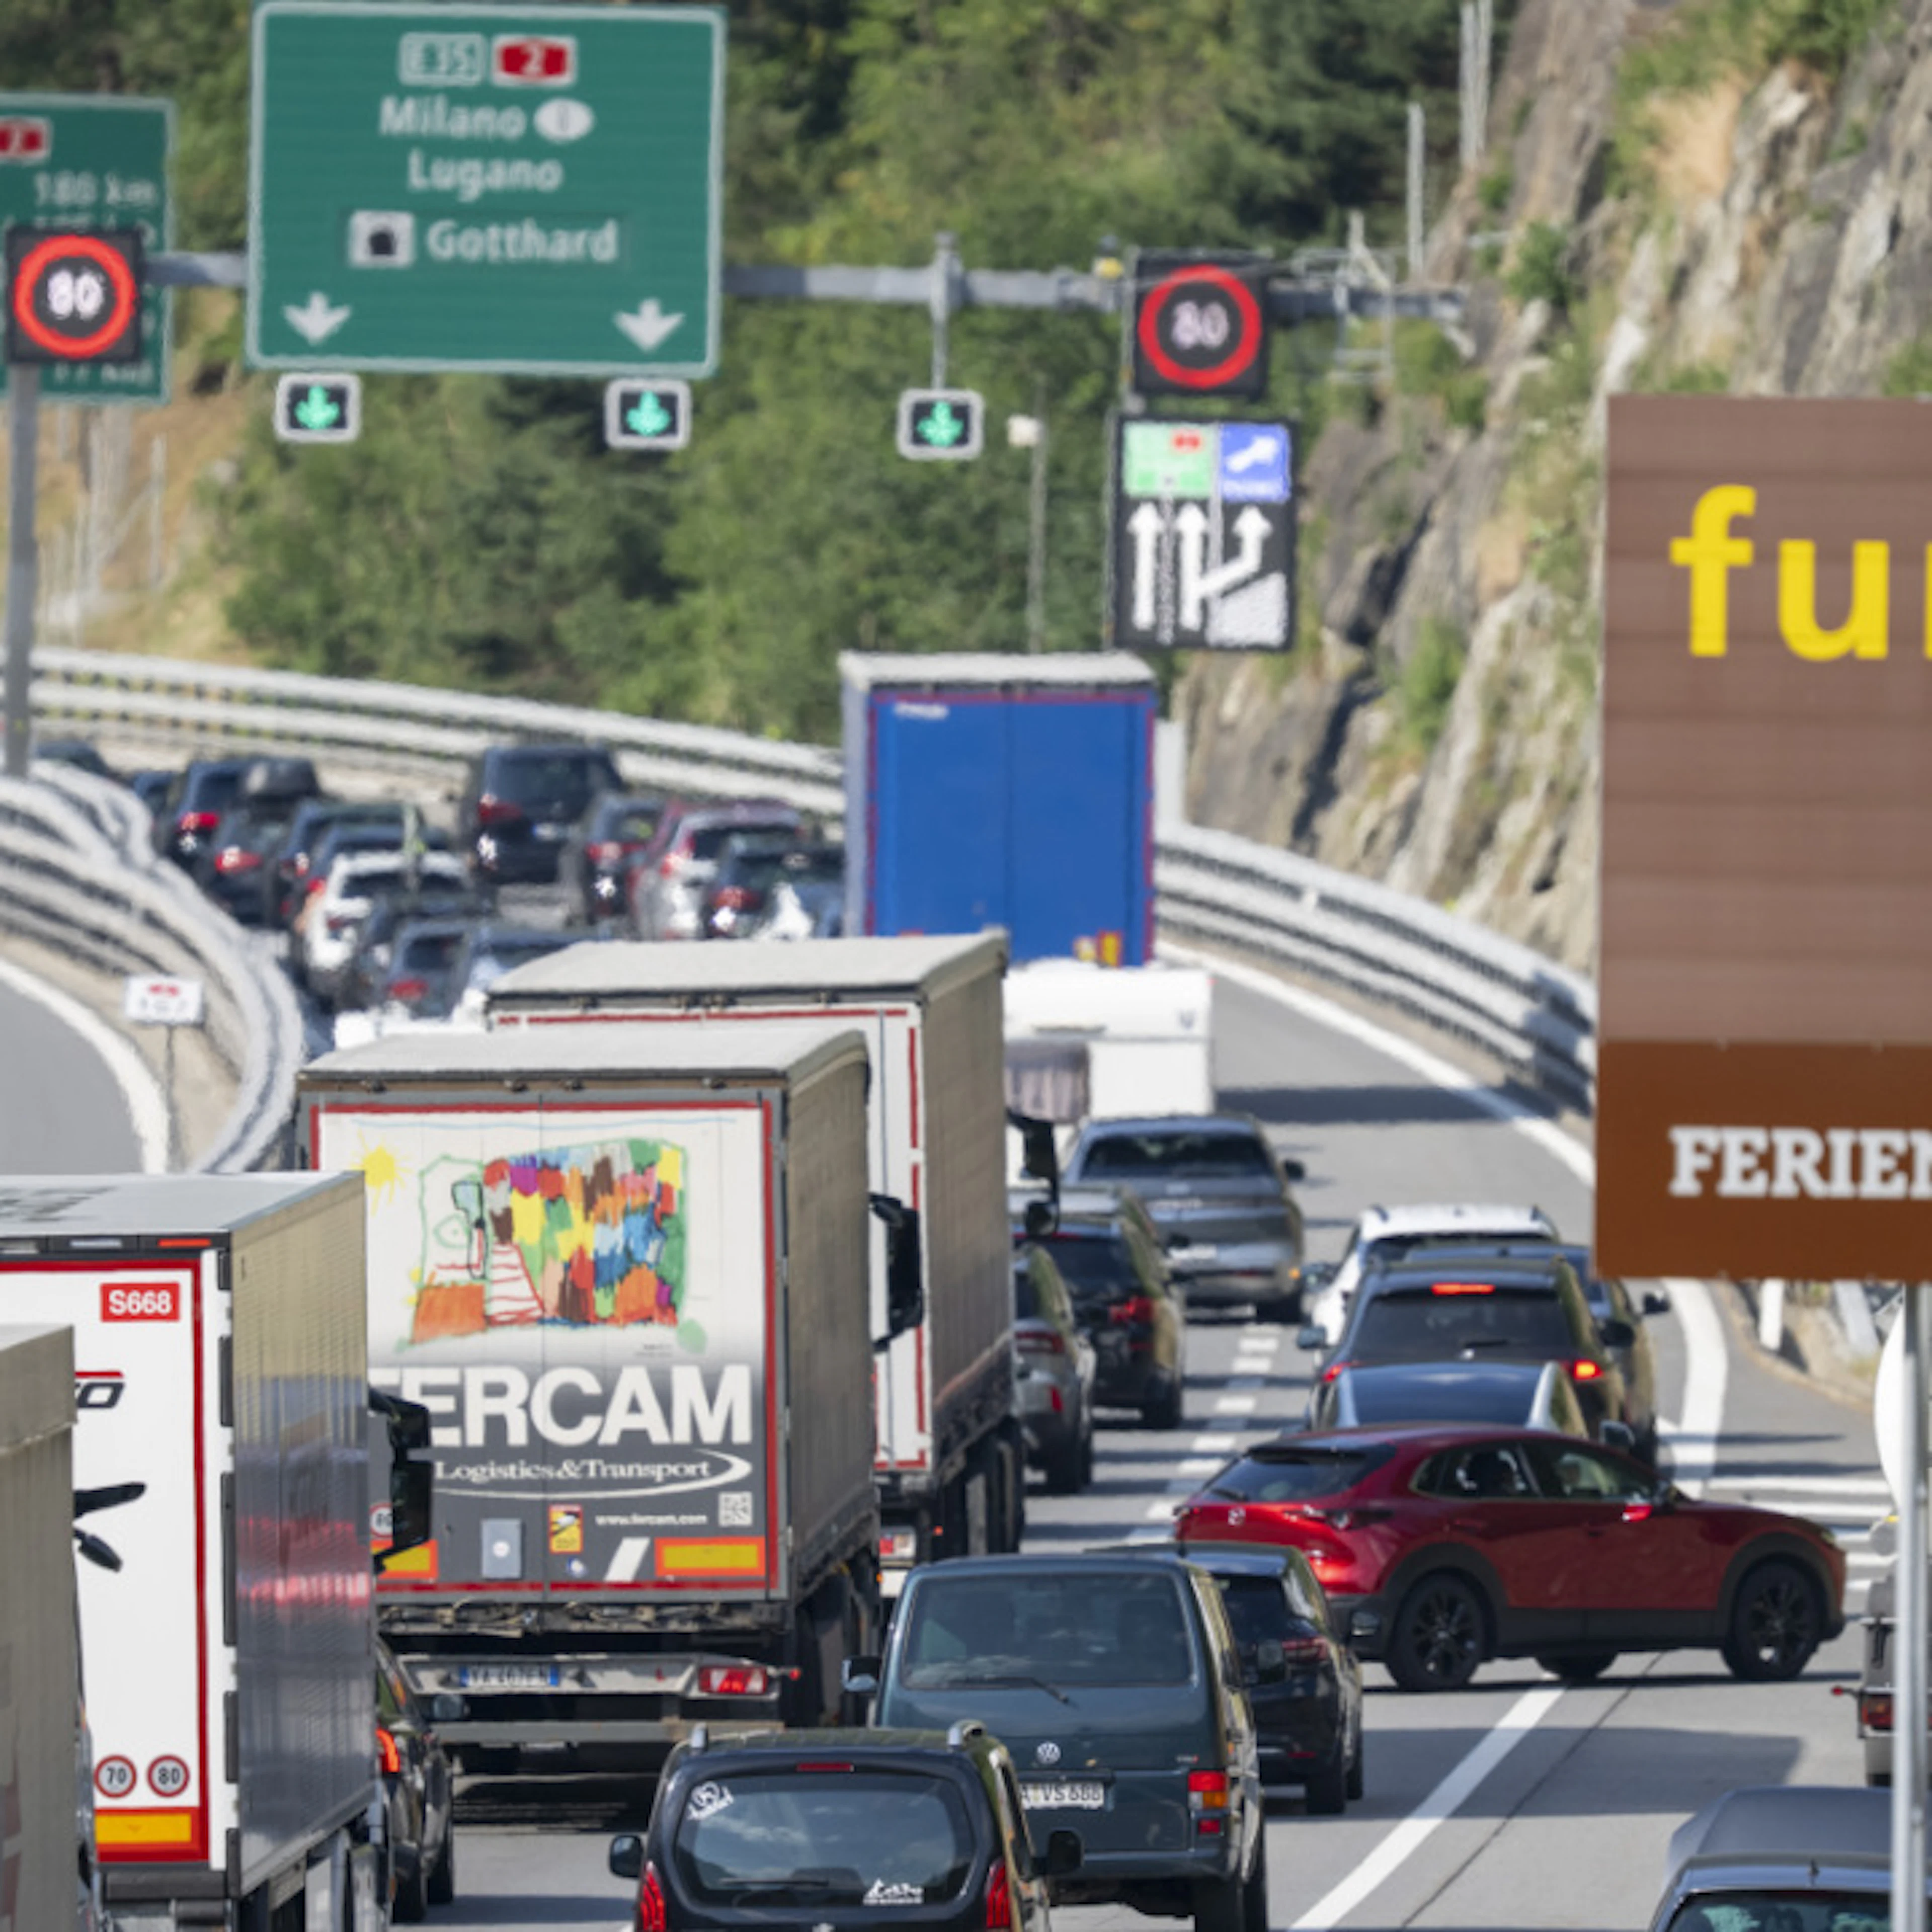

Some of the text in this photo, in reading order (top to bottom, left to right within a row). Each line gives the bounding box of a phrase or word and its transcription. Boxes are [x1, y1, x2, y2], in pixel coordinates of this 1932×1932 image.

[521, 45, 546, 76] 2
[380, 96, 526, 139] Milano
[408, 149, 563, 202] Lugano
[427, 220, 618, 263] Gotthard
[1669, 484, 1932, 661] fu
[108, 1290, 172, 1315] S668
[435, 1459, 710, 1483] Logistics&Transport
[107, 1767, 127, 1785] 70
[158, 1766, 180, 1785] 80
